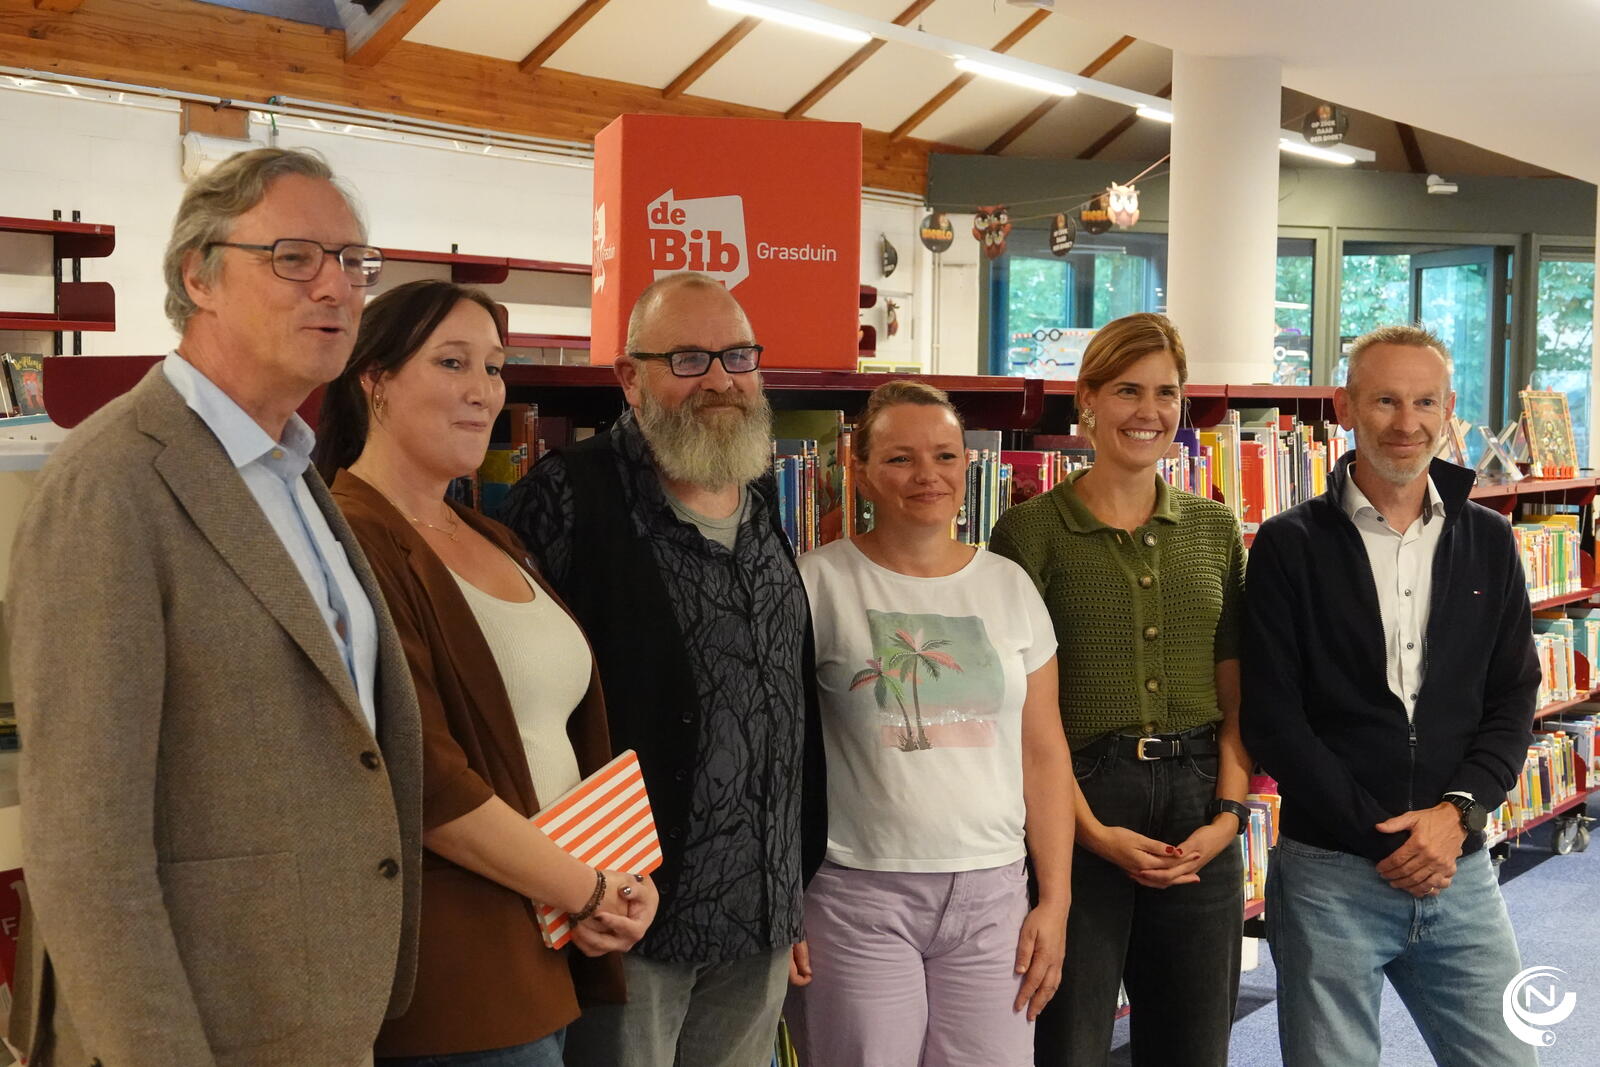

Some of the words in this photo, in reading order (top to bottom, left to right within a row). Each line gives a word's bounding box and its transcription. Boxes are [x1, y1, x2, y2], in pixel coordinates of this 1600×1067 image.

[650, 201, 686, 225] de
[649, 229, 740, 273] Bib
[756, 242, 837, 262] Grasduin
